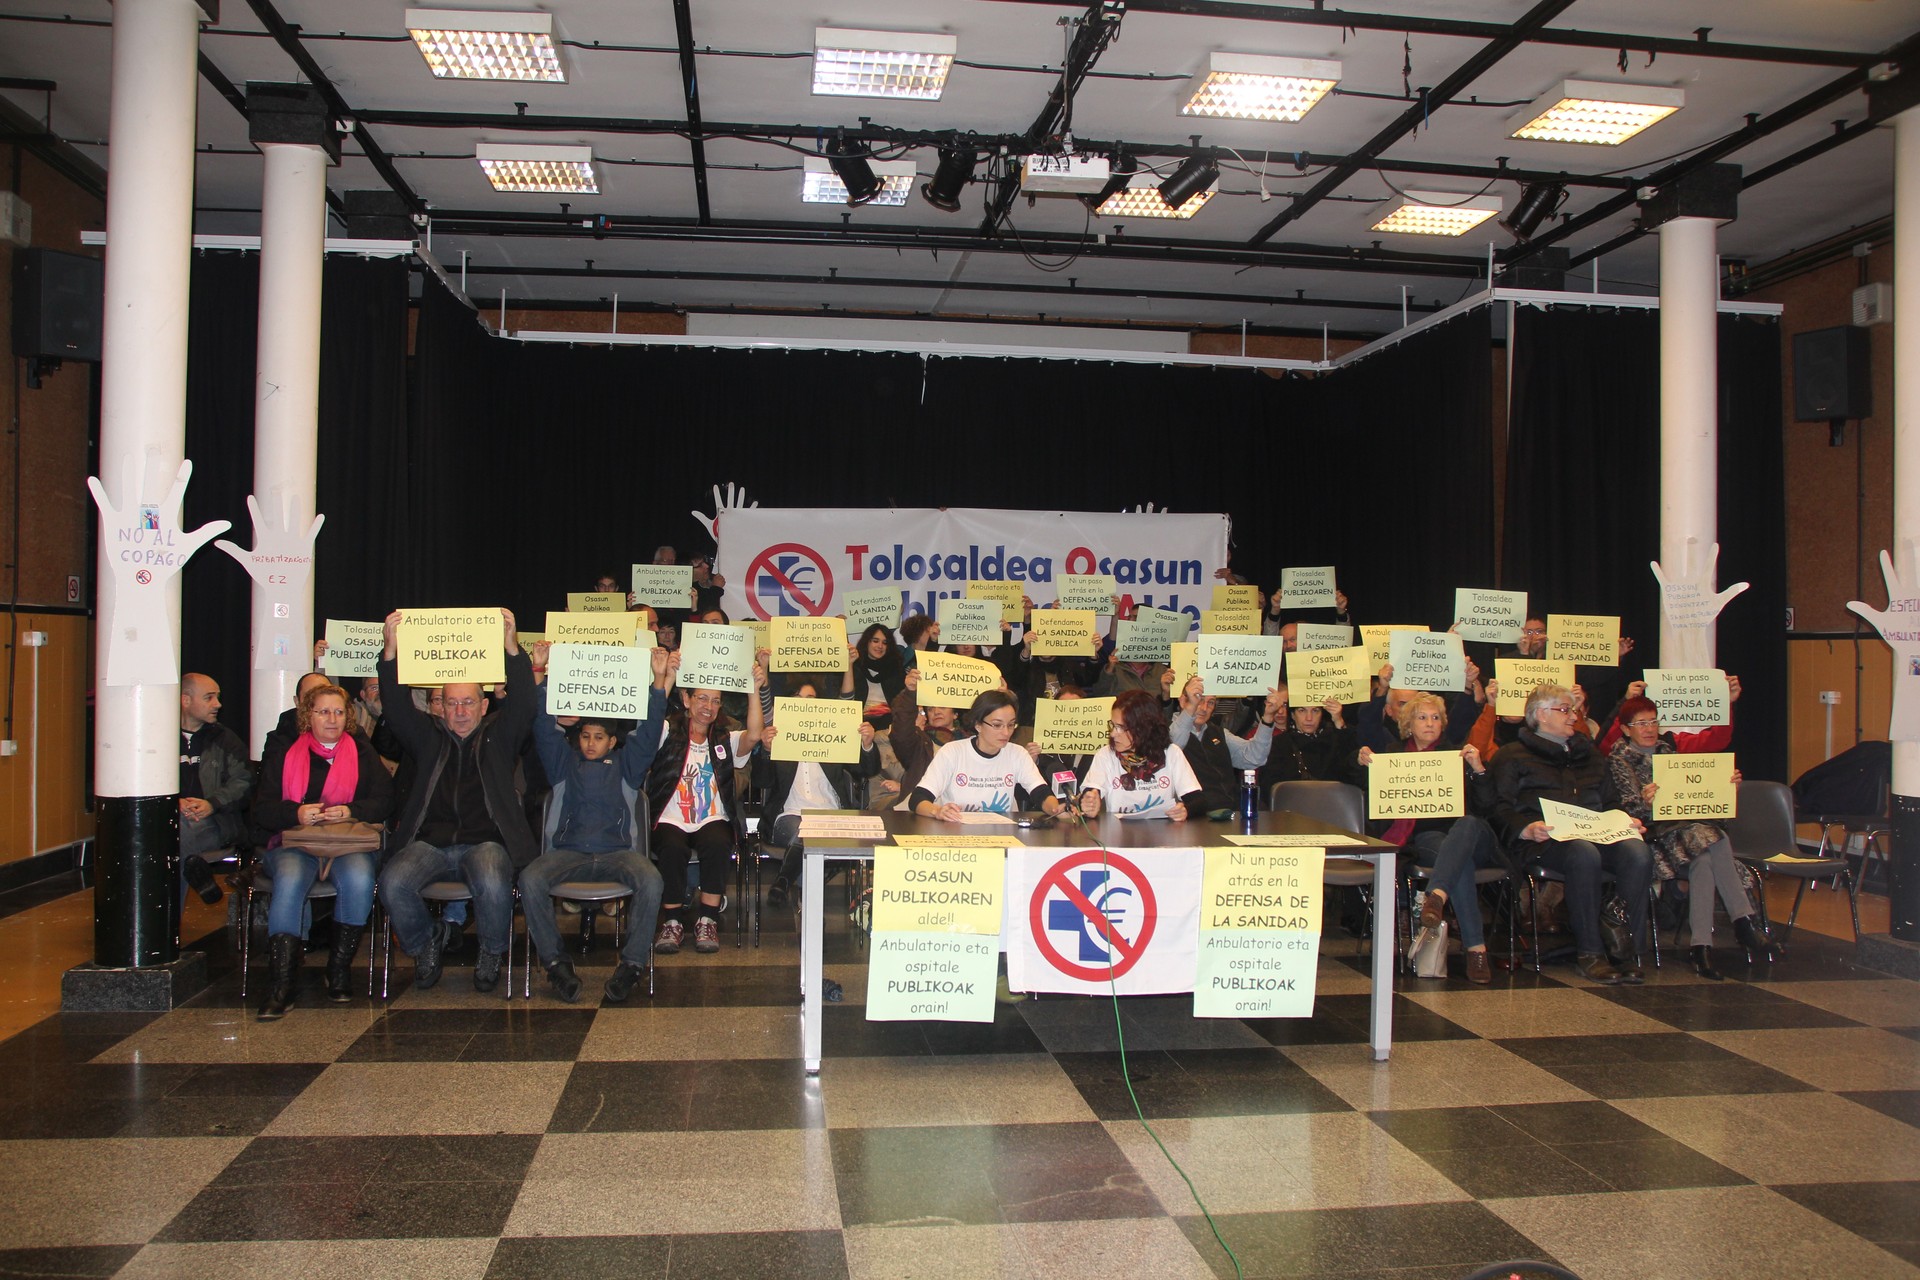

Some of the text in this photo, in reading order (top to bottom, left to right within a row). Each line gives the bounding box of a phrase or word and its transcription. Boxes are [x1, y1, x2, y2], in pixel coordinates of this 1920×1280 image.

[119, 528, 175, 546] NO AL
[121, 550, 186, 567] COPAGO
[845, 545, 1203, 585] Tolosaldea Osasun
[269, 575, 287, 584] EZ
[649, 578, 675, 586] ospitale
[641, 587, 682, 595] PUBLIKOAK
[1284, 588, 1333, 596] PUBLIKOAREN
[1665, 583, 1697, 592] OSASUN
[851, 596, 891, 606] Defendamos
[1472, 593, 1512, 603] Tolosaldea
[862, 605, 897, 614] SANIDAD
[1473, 606, 1511, 615] OSASUN
[404, 614, 495, 625] Anbulatorio eta
[858, 615, 890, 624] PUBLICA
[1040, 618, 1083, 626] Defendamos
[1460, 617, 1521, 627] PUBLIKOAREN
[558, 625, 619, 634] Defendamos
[787, 621, 796, 629] Ni
[812, 623, 831, 631] paso
[952, 623, 988, 631] DEFENDA
[427, 632, 472, 645] ospitale
[696, 629, 744, 642] La sanidad
[786, 634, 809, 642] atrás
[825, 634, 832, 642] la
[1480, 631, 1501, 639] alde!!
[1597, 631, 1604, 639] la
[1415, 636, 1445, 645] Osasun
[712, 645, 729, 655] NO
[778, 647, 839, 655] DEFENSA DE
[1554, 641, 1611, 651] DEFENSA DE
[414, 649, 486, 660] PUBLIKOAK
[1210, 646, 1267, 657] Defendamos
[1411, 650, 1446, 659] Publikoa
[571, 650, 584, 660] Ni
[604, 654, 628, 664] paso
[1311, 655, 1344, 664] Osasun
[1568, 654, 1610, 662] SANIDAD
[712, 662, 739, 672] vende
[777, 660, 840, 668] LA SANIDAD
[928, 659, 984, 670] Defendamos
[1206, 661, 1271, 670] LA SANIDAD
[1406, 663, 1449, 673] DEFENDA
[1513, 663, 1560, 673] Tolosaldea
[435, 667, 466, 677] orain!
[569, 667, 598, 678] atrás
[619, 669, 627, 679] la
[1310, 668, 1347, 677] Publikoa
[683, 674, 748, 688] SE DEFIENDE
[925, 672, 992, 684] LA SANIDAD
[1217, 675, 1257, 684] PUBLICA
[1404, 677, 1450, 686] DEZAGUN
[1514, 677, 1558, 685] OSASUN
[1689, 675, 1709, 683] paso
[559, 683, 637, 697] DEFENSA DE
[1306, 680, 1353, 690] DEFENDA
[1662, 686, 1687, 694] atrás
[1704, 686, 1712, 694] la
[937, 686, 982, 699] PUBLICA
[557, 700, 636, 713] LA SANIDAD
[780, 703, 856, 714] Anbulatorio eta
[1655, 699, 1720, 708] DEFENSA DE
[1672, 713, 1720, 721] SANIDAD
[799, 719, 836, 730] ospitale
[786, 732, 846, 743] PUBLIKOAK
[802, 749, 829, 757] orain!
[1389, 759, 1401, 768] Ni
[1420, 759, 1442, 770] paso
[1668, 759, 1715, 769] La sanidad
[1389, 773, 1416, 784] atrás
[1435, 772, 1443, 782] la
[1686, 775, 1702, 783] NO
[1380, 787, 1453, 799] DEFENSA DE
[1687, 789, 1714, 799] vende
[1379, 803, 1453, 814] LA SANIDAD
[1659, 804, 1728, 815] SE DEFIENDE
[903, 848, 976, 862] Tolosaldea
[1231, 852, 1298, 869] Ni un paso
[905, 870, 972, 883] OSASUN
[1229, 874, 1298, 887] atrás en la
[882, 890, 992, 905] PUBLIKOAREN
[1216, 894, 1309, 908] DEFENSA DE
[918, 912, 954, 925] alde!!
[1213, 915, 1308, 929] LA SANIDAD
[880, 938, 988, 955] Anbulatorio eta
[1206, 936, 1309, 950] Anbulatorio eta
[905, 960, 959, 975] ospitale
[1229, 958, 1281, 973] ospitale
[888, 981, 974, 994] PUBLIKOAK
[1213, 977, 1295, 991] PUBLIKOAK
[911, 1001, 948, 1013] orain!
[1236, 999, 1271, 1011] orain!
